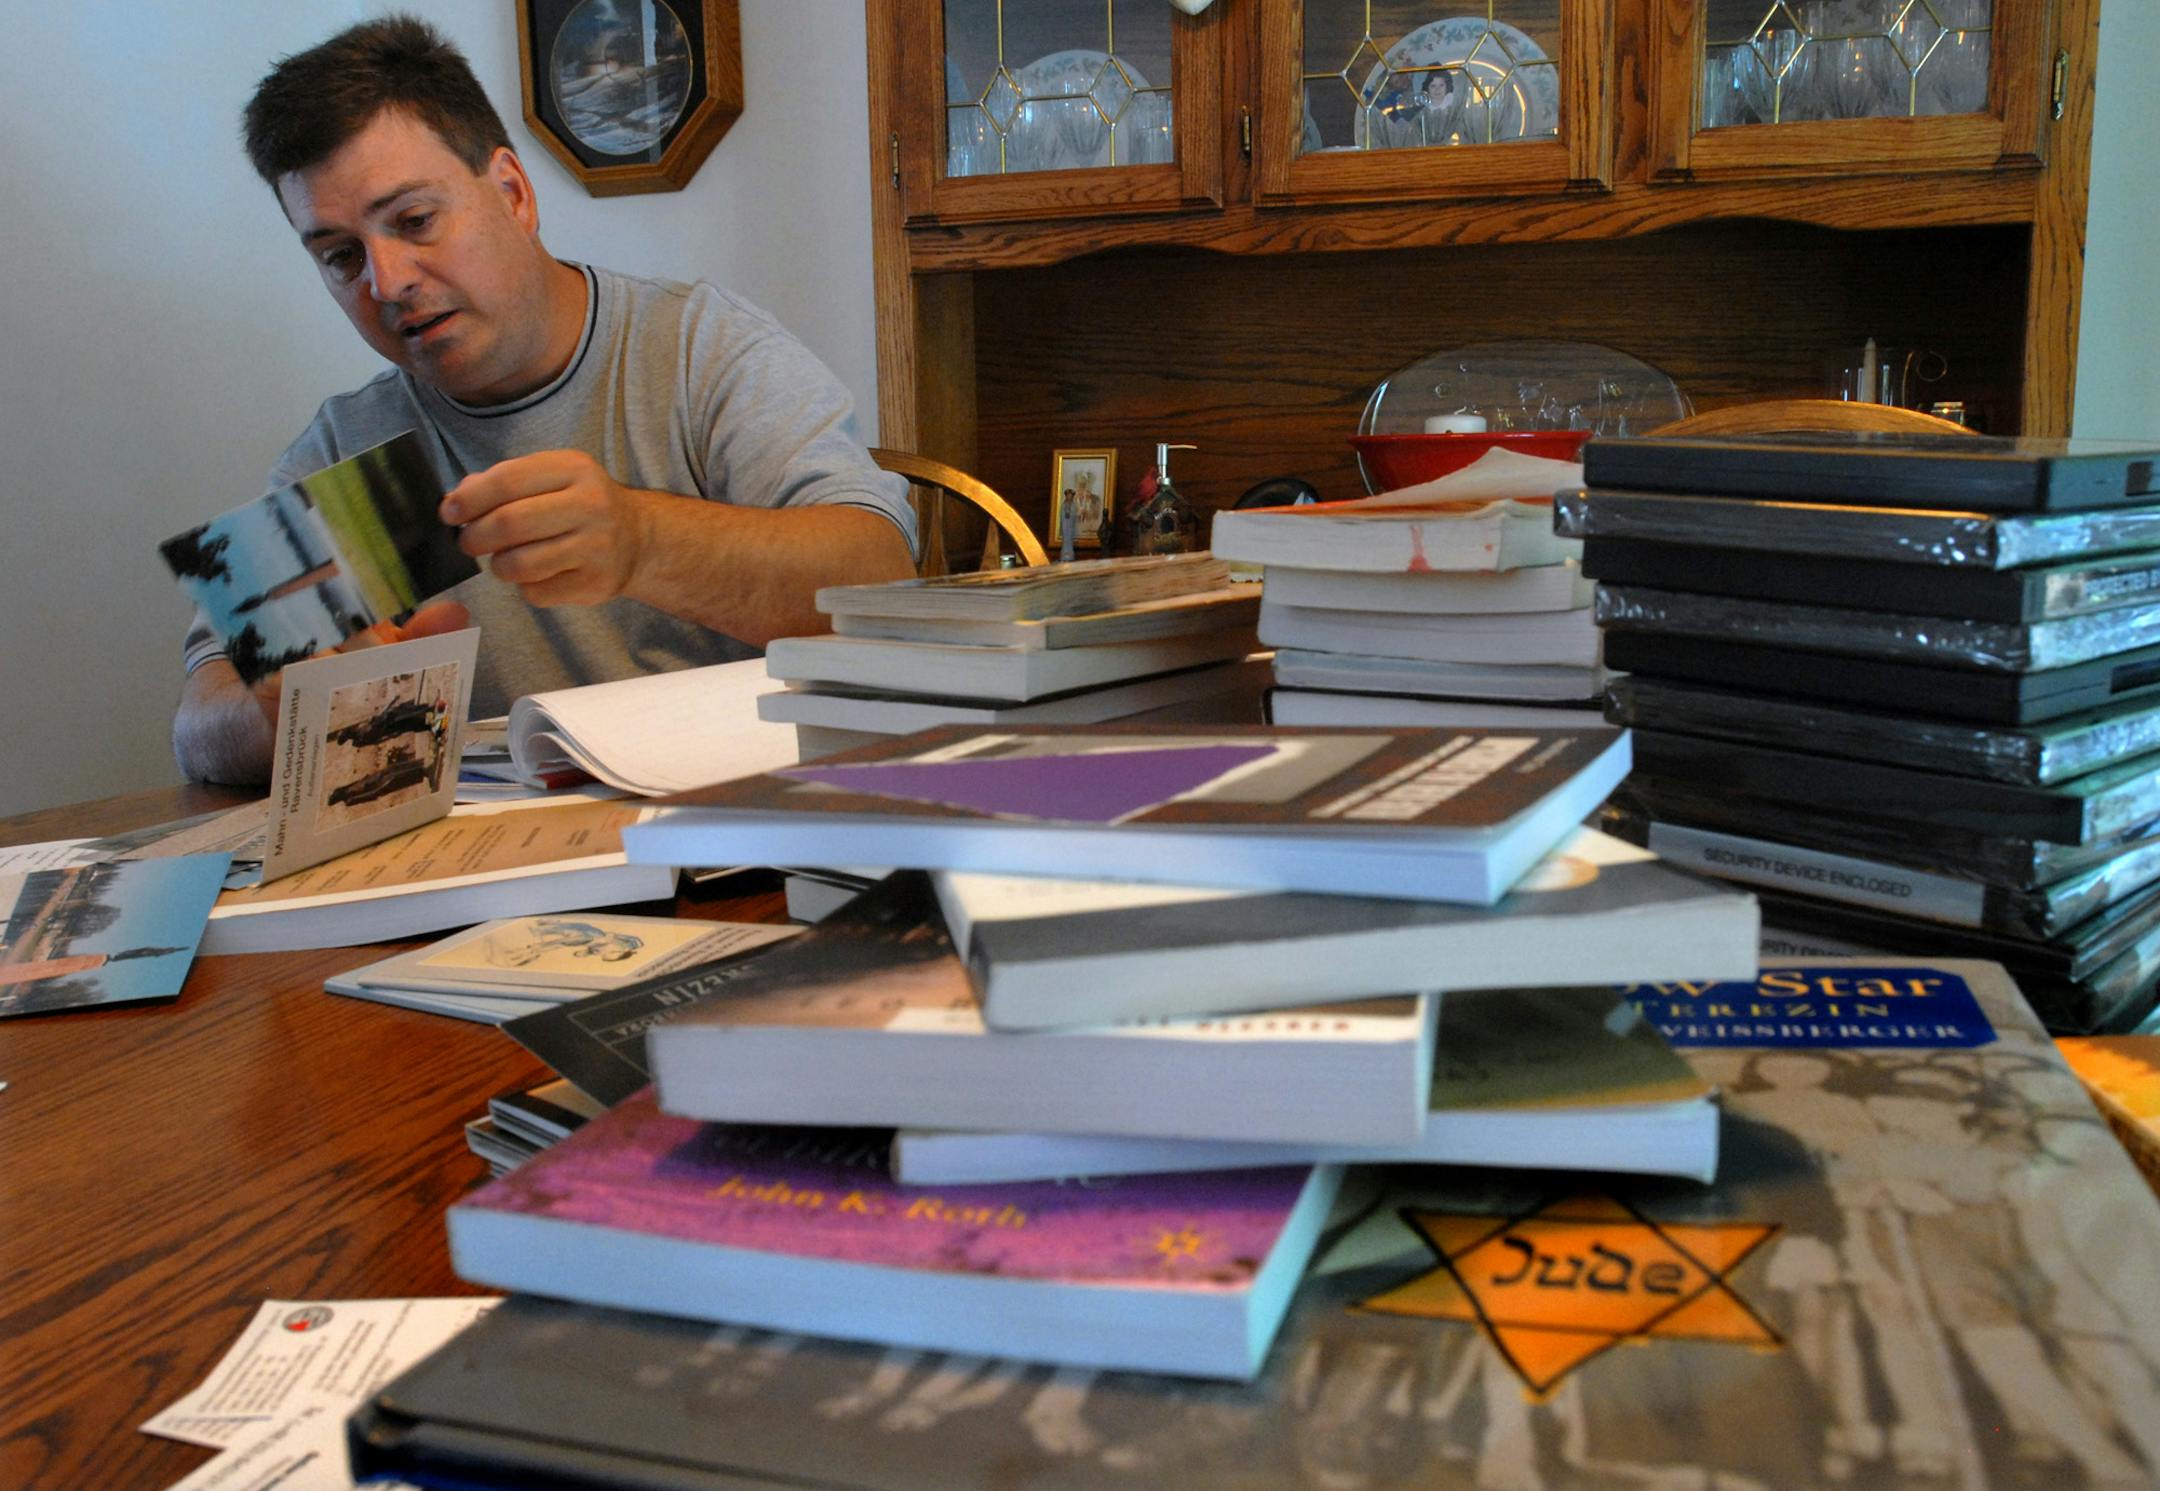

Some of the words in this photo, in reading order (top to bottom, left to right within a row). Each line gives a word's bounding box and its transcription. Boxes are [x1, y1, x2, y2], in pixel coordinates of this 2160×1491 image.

[290, 726, 308, 813] Ravensbrück
[274, 819, 287, 856] Mahn
[282, 783, 291, 809] und
[1703, 848, 1771, 871] SECURITY
[1774, 859, 1826, 883] DEVICE
[1829, 870, 1912, 898] ENCLOSED
[1757, 970, 1943, 998] Star
